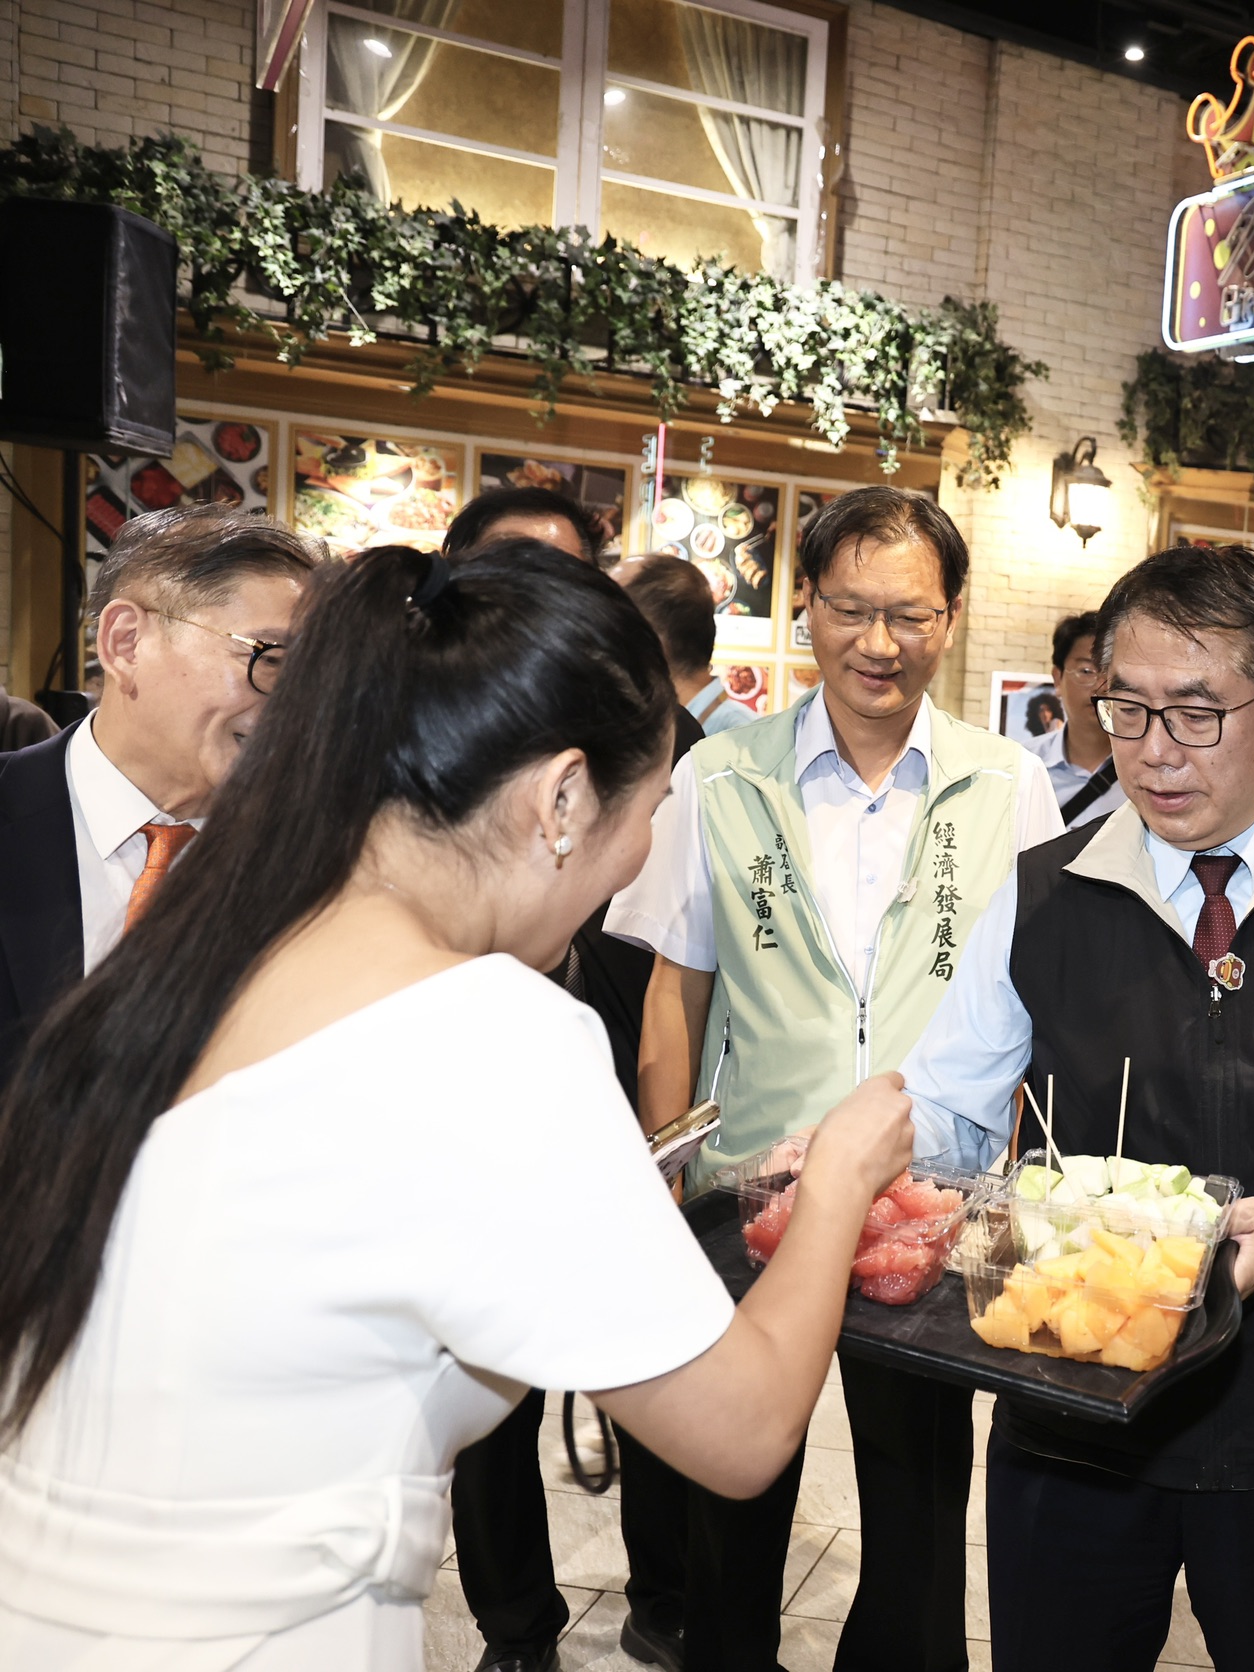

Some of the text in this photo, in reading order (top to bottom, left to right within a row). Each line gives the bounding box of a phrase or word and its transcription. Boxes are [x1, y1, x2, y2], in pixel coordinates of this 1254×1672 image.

[748, 854, 779, 951] 蕭富仁
[929, 821, 962, 982] 經濟發展局
